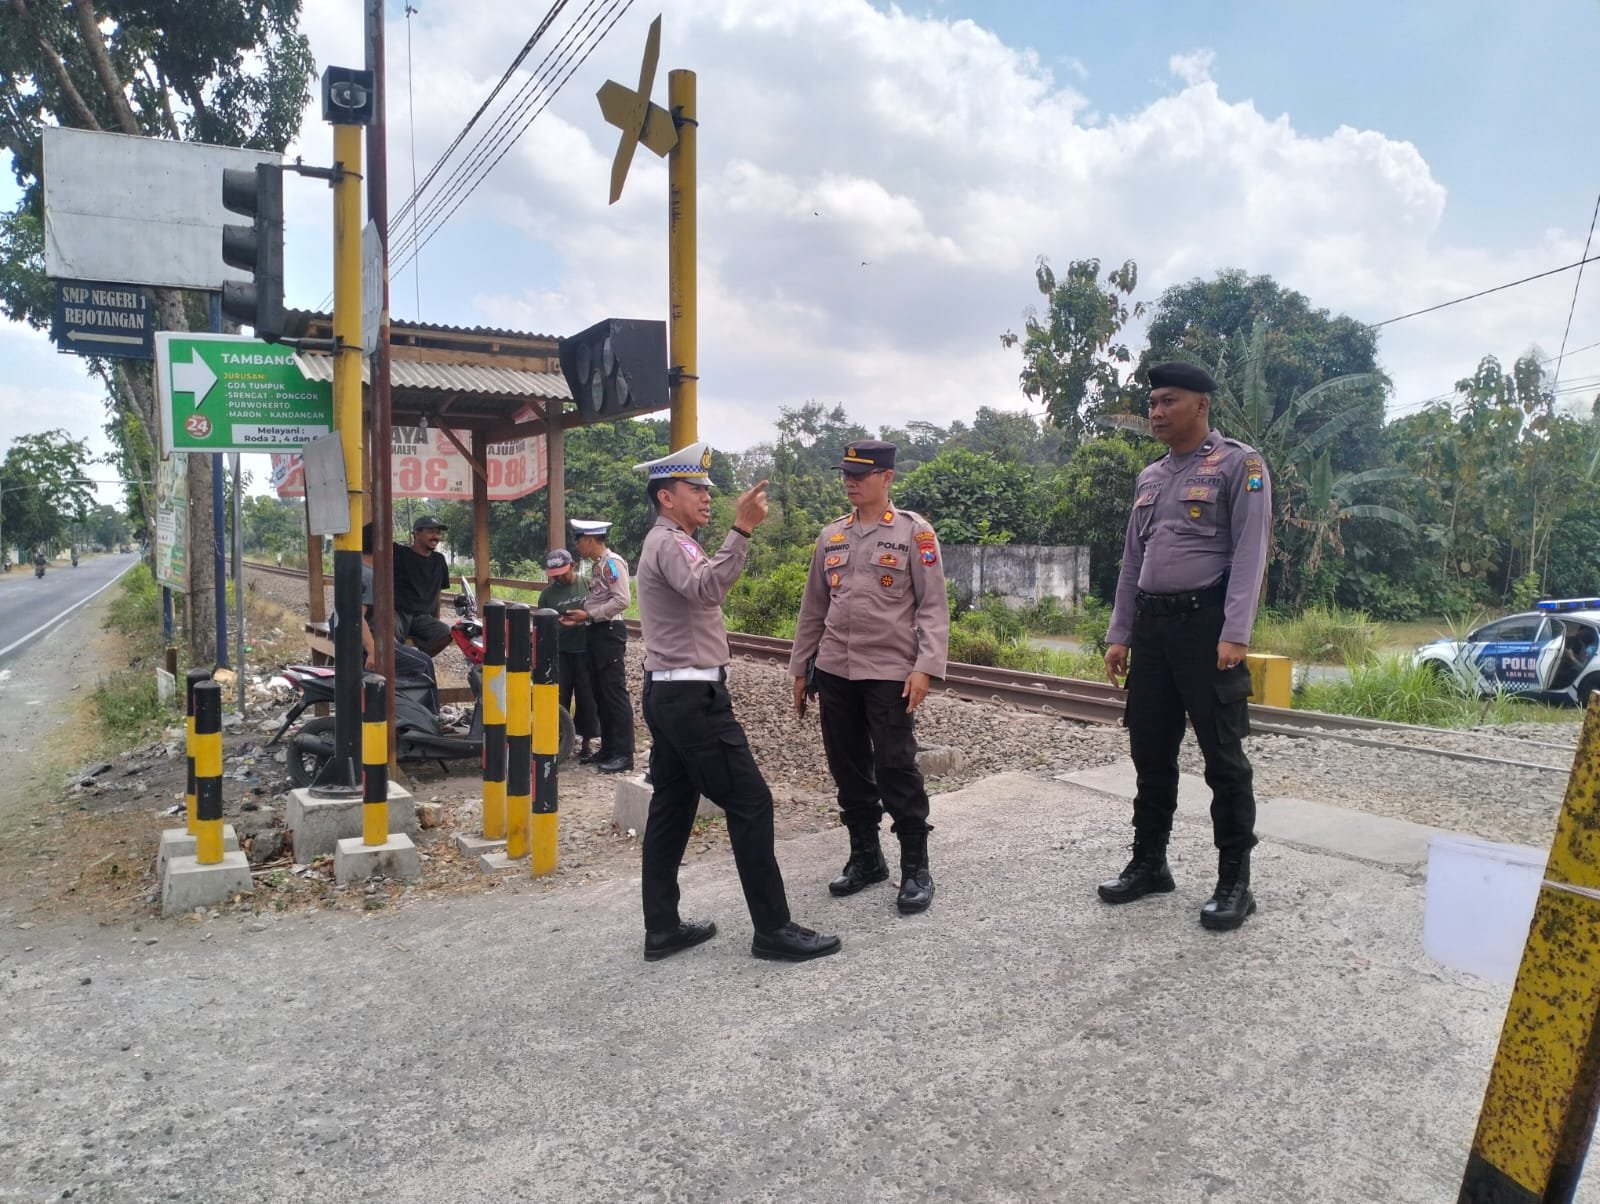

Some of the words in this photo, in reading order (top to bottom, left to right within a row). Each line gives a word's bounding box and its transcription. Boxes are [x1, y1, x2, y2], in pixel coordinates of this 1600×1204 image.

[62, 287, 89, 304] SMP
[91, 289, 137, 309] NEGERI
[140, 295, 146, 310] 1
[64, 307, 144, 329] REJOTANGAN
[221, 353, 296, 366] TAMBANG
[223, 372, 267, 380] JURUSAN:
[249, 382, 285, 390] TUMPUK
[270, 411, 325, 419] KANDANGAN
[187, 418, 209, 433] 24
[257, 427, 299, 435] Melayani
[1186, 477, 1221, 486] POLRI
[877, 541, 909, 553] POLRI
